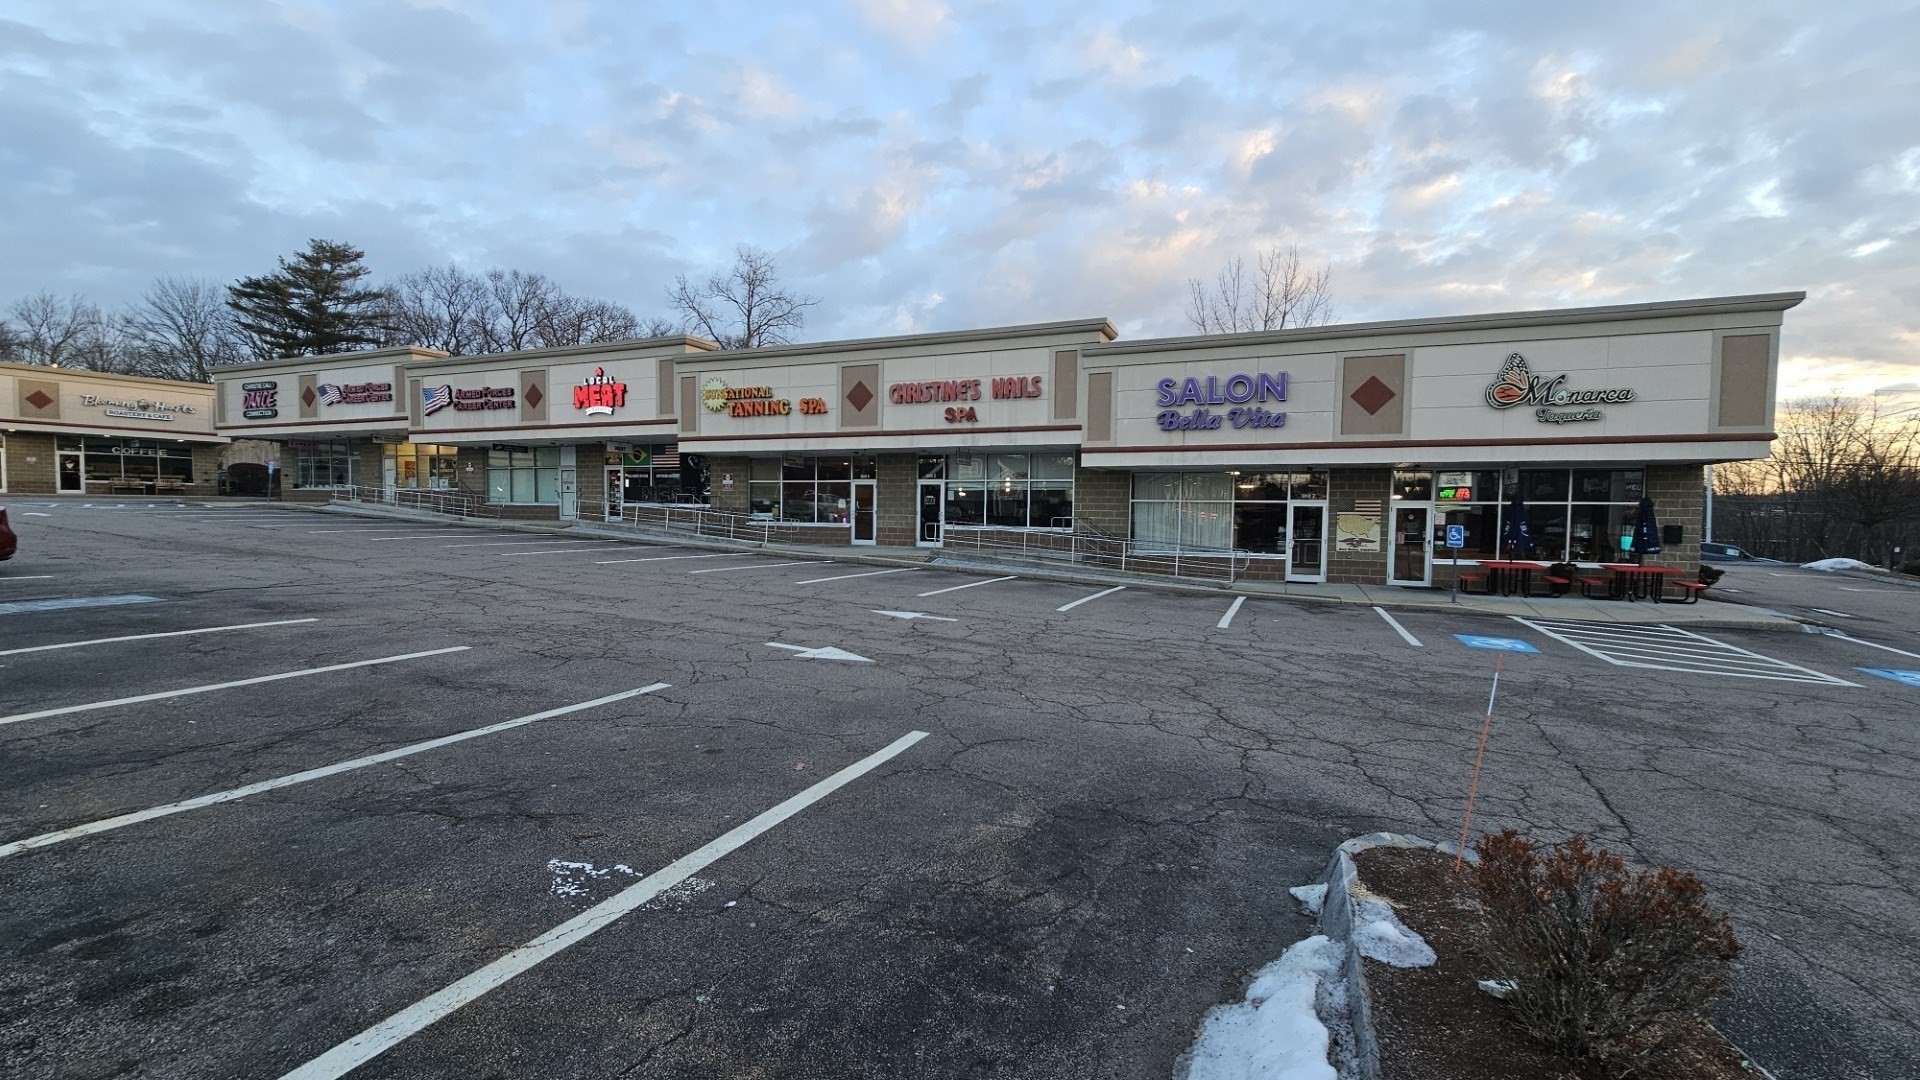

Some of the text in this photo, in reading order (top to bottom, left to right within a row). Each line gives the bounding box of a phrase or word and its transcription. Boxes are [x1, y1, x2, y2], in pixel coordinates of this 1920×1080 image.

[583, 376, 614, 385] LOCAL
[1157, 371, 1288, 406] SALON
[1527, 373, 1635, 405] Monarca
[454, 387, 514, 399] ARMED FORCES
[573, 383, 627, 409] MEAT
[703, 386, 773, 401] SUNSATIONAL
[888, 375, 1042, 404] CHRISTINE'S NAILS
[81, 394, 138, 411] Blooming
[243, 391, 277, 409] DANCE
[452, 399, 515, 411] CAREER CENTER
[726, 398, 828, 417] TANNING SPA
[108, 410, 146, 419] ROASTERY
[944, 406, 978, 423] SPA
[1156, 407, 1287, 431] Bella Vita
[111, 446, 168, 456] COFFEE
